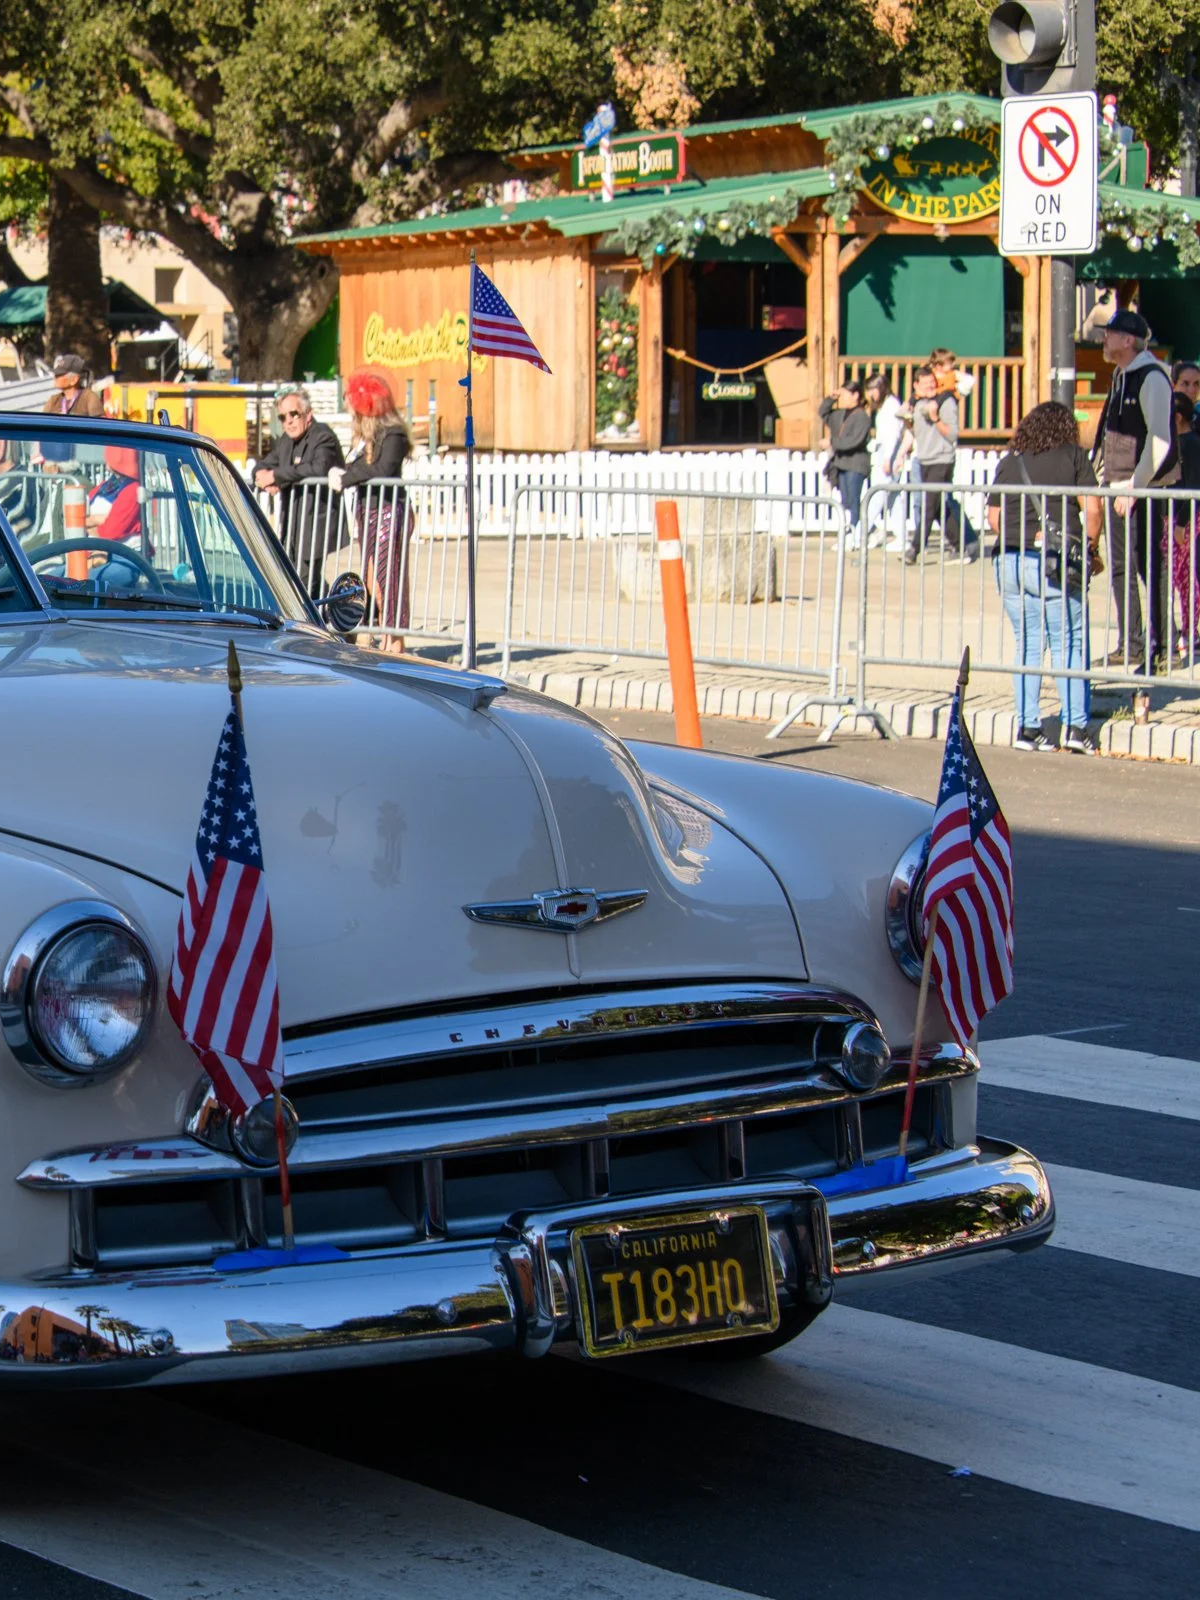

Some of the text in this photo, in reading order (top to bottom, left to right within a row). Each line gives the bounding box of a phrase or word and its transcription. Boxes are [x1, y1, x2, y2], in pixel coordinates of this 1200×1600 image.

[638, 142, 673, 176] BOOTH
[868, 173, 898, 204] IN
[900, 192, 950, 218] THE
[1035, 193, 1061, 215] ON
[1027, 221, 1067, 245] RED
[621, 1231, 718, 1260] CALIFORNIA
